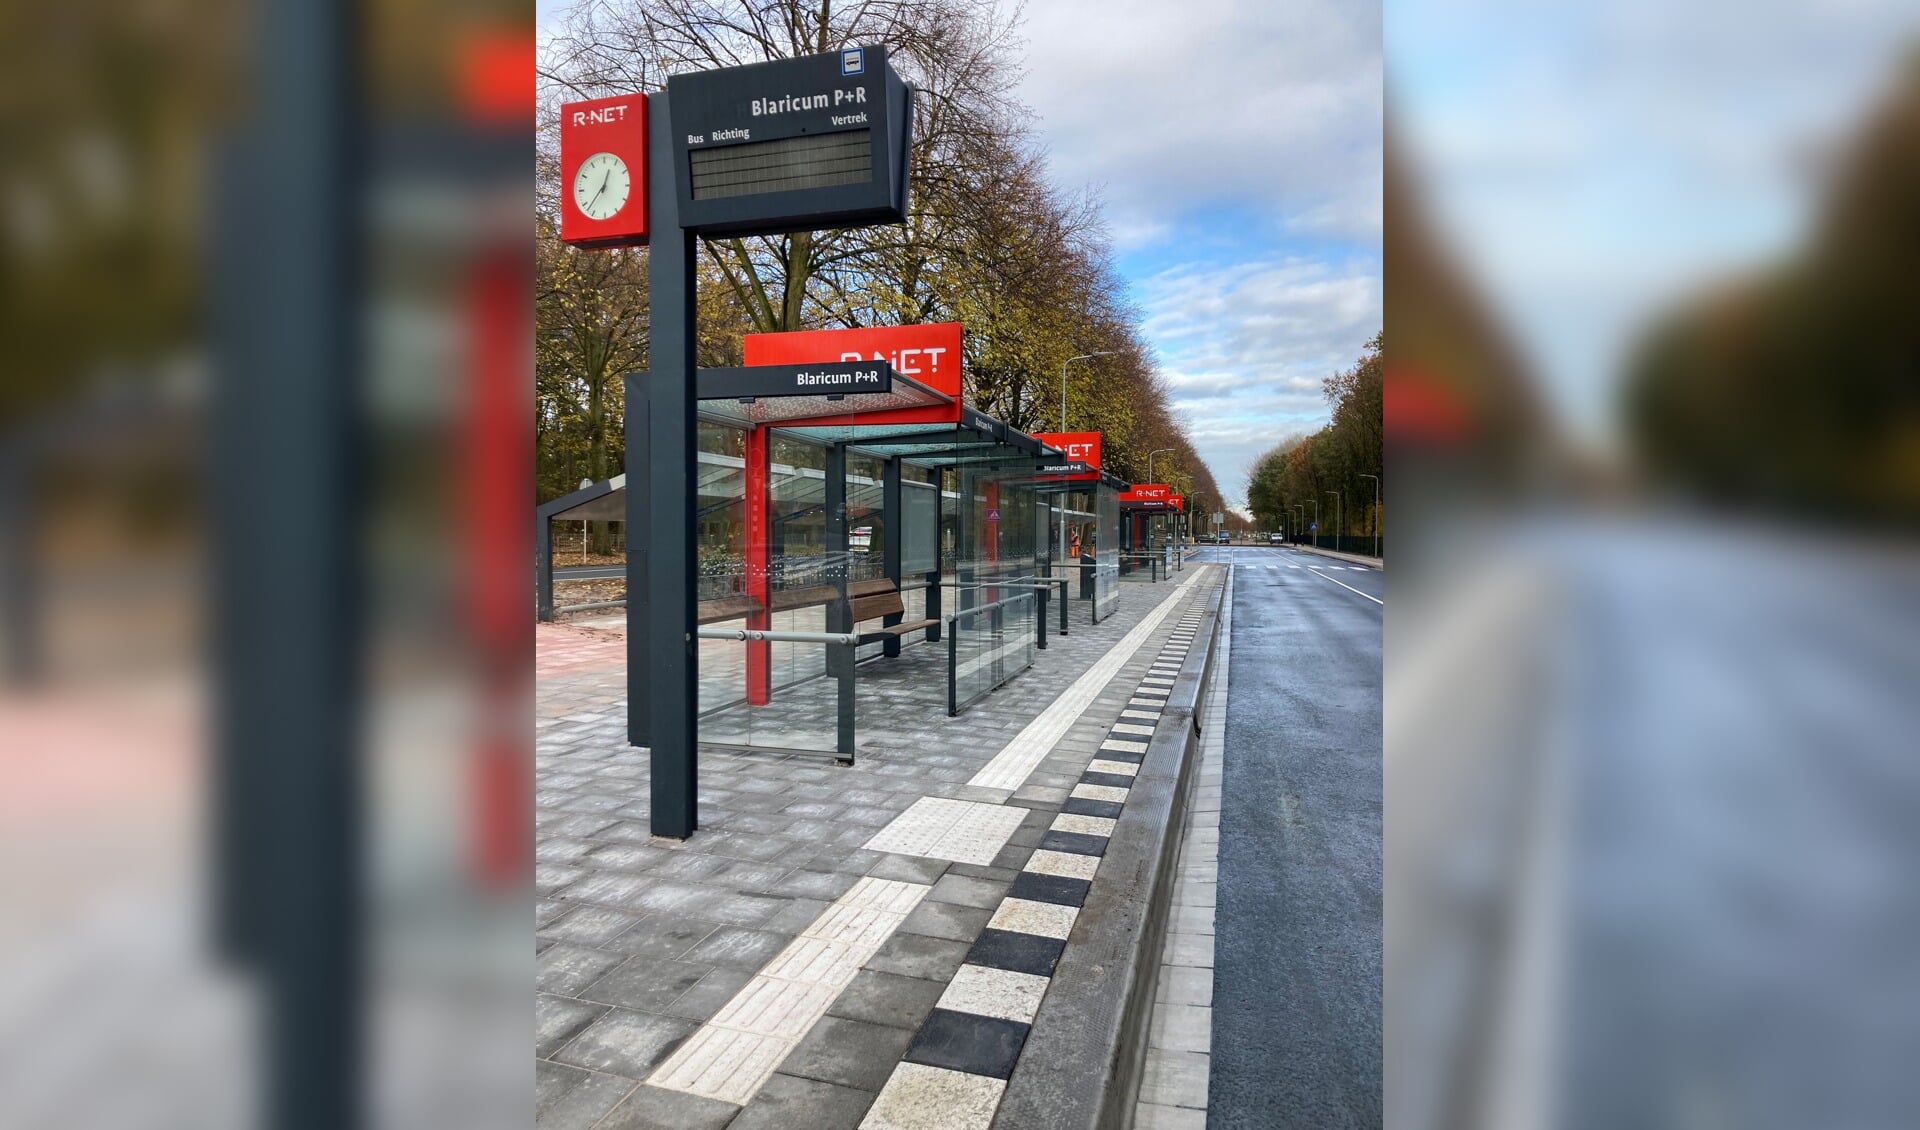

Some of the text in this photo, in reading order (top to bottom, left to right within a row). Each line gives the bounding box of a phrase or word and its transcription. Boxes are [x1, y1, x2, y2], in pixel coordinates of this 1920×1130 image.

[752, 87, 867, 116] Blaricum P+R
[831, 112, 868, 126] Vertrek
[688, 128, 750, 144] Bus Richting
[797, 370, 879, 385] Blaricum P+R
